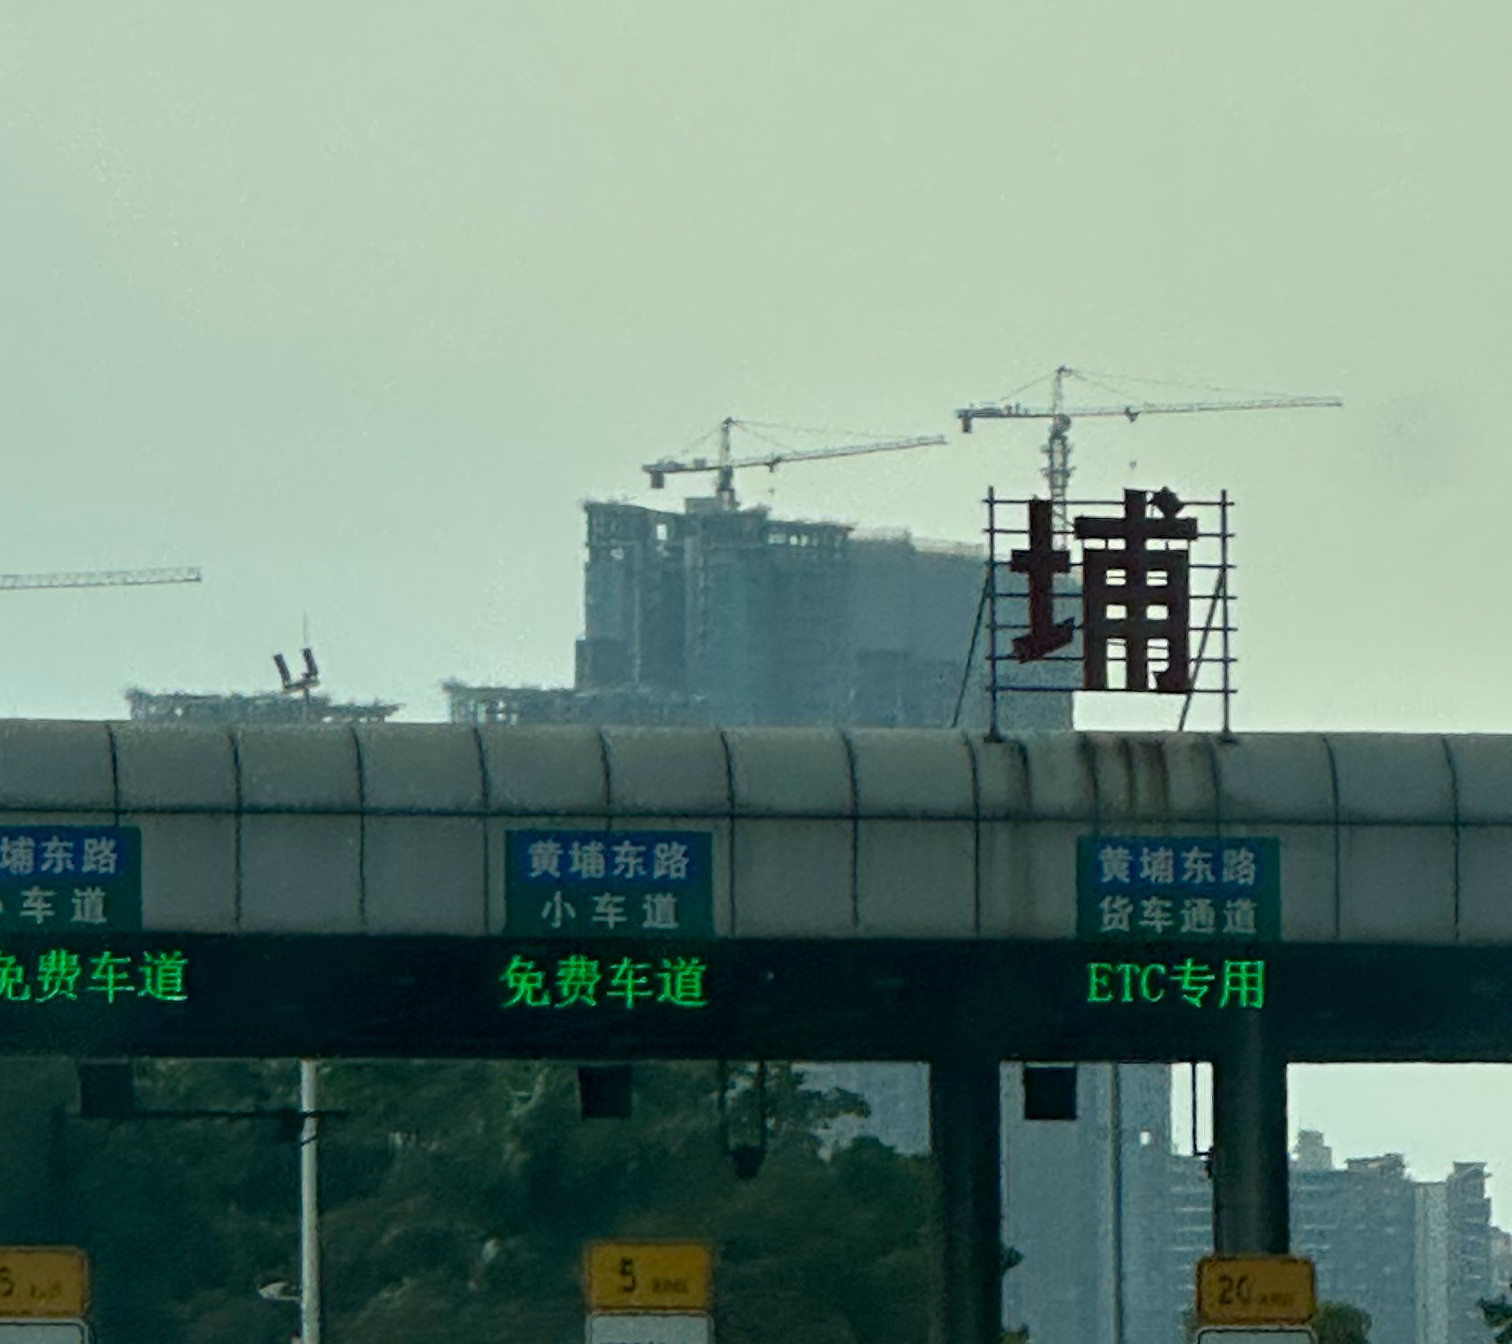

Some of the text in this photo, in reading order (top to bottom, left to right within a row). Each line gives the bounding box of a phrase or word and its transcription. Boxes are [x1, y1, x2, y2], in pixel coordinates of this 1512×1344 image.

[1010, 486, 1197, 692] 埔
[528, 838, 689, 880] 黄埔东路
[1098, 845, 1256, 885] 黄埔东路
[541, 890, 680, 929] 小车道
[1099, 895, 1257, 934] 货车通道
[499, 955, 709, 1009] 免费车道
[1087, 958, 1265, 1008] ETC专用
[620, 1258, 636, 1292] 5
